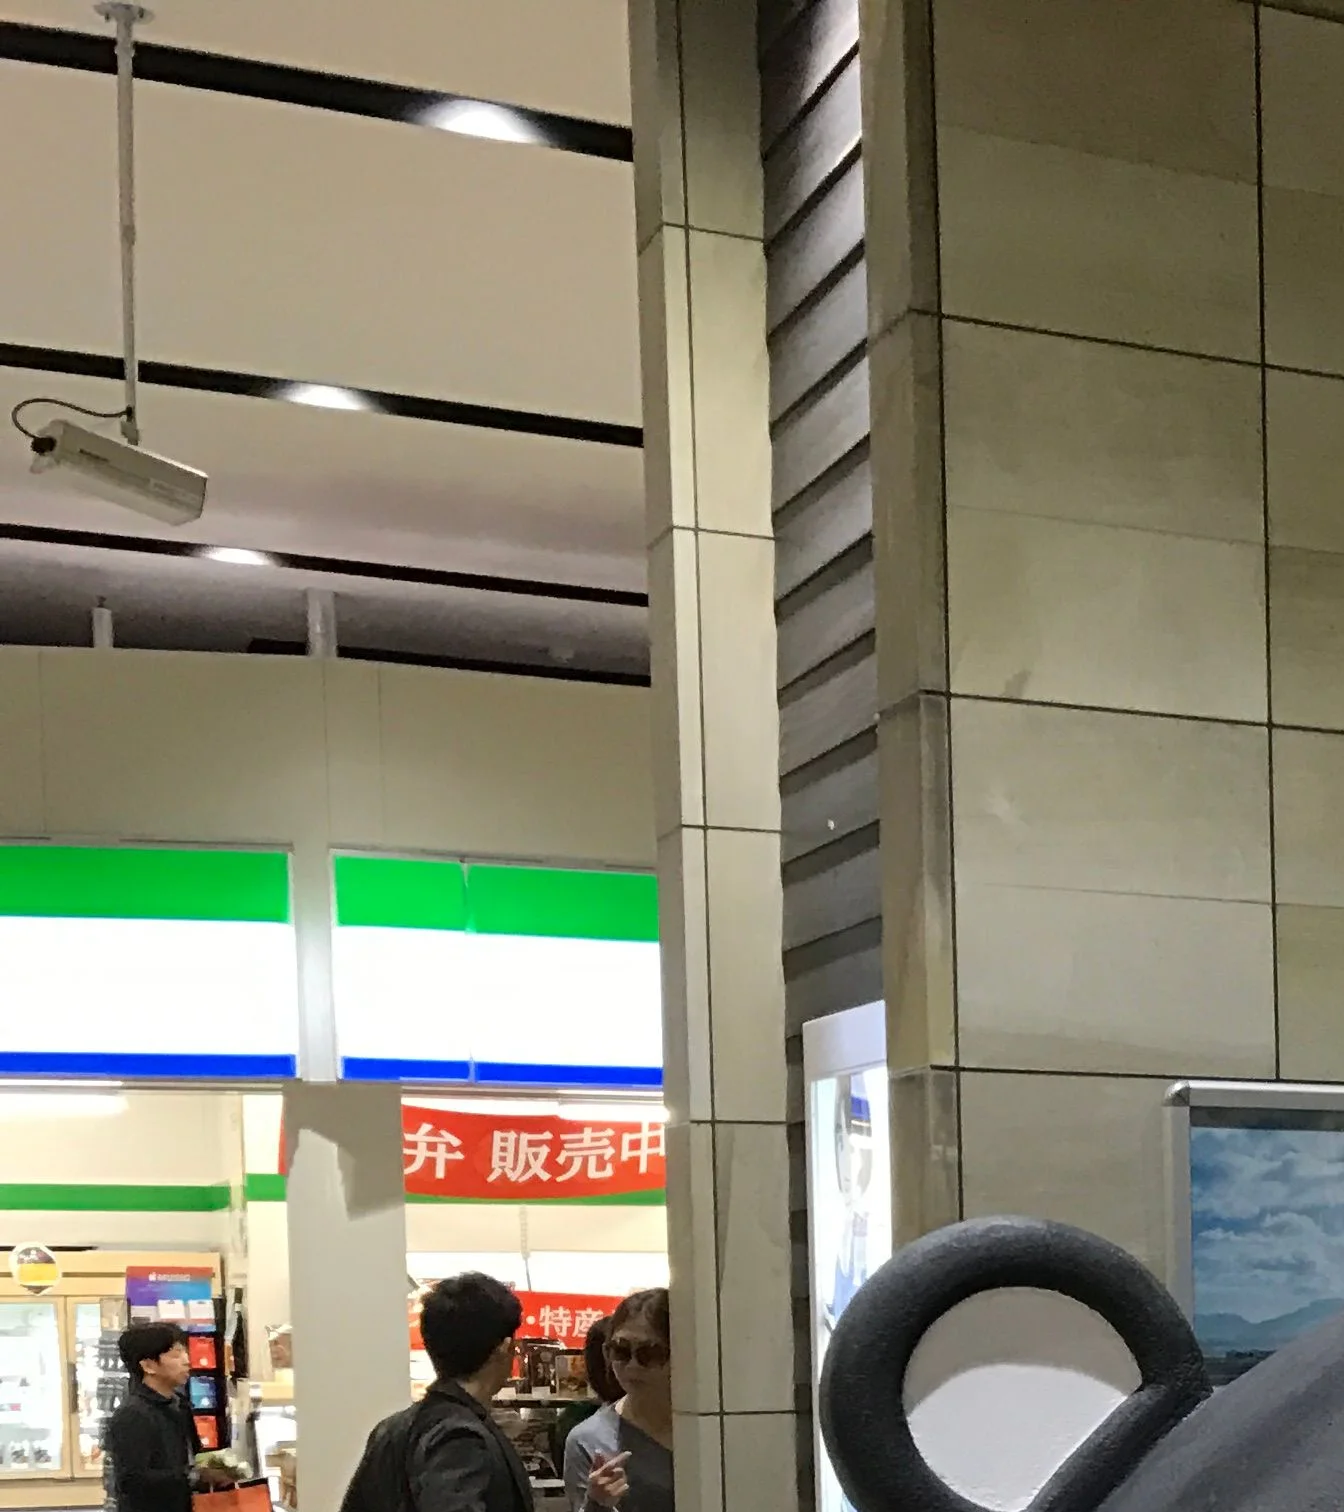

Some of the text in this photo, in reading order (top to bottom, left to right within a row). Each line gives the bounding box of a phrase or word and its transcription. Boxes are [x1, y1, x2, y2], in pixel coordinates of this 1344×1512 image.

[403, 1119, 666, 1183] 弁 販売中
